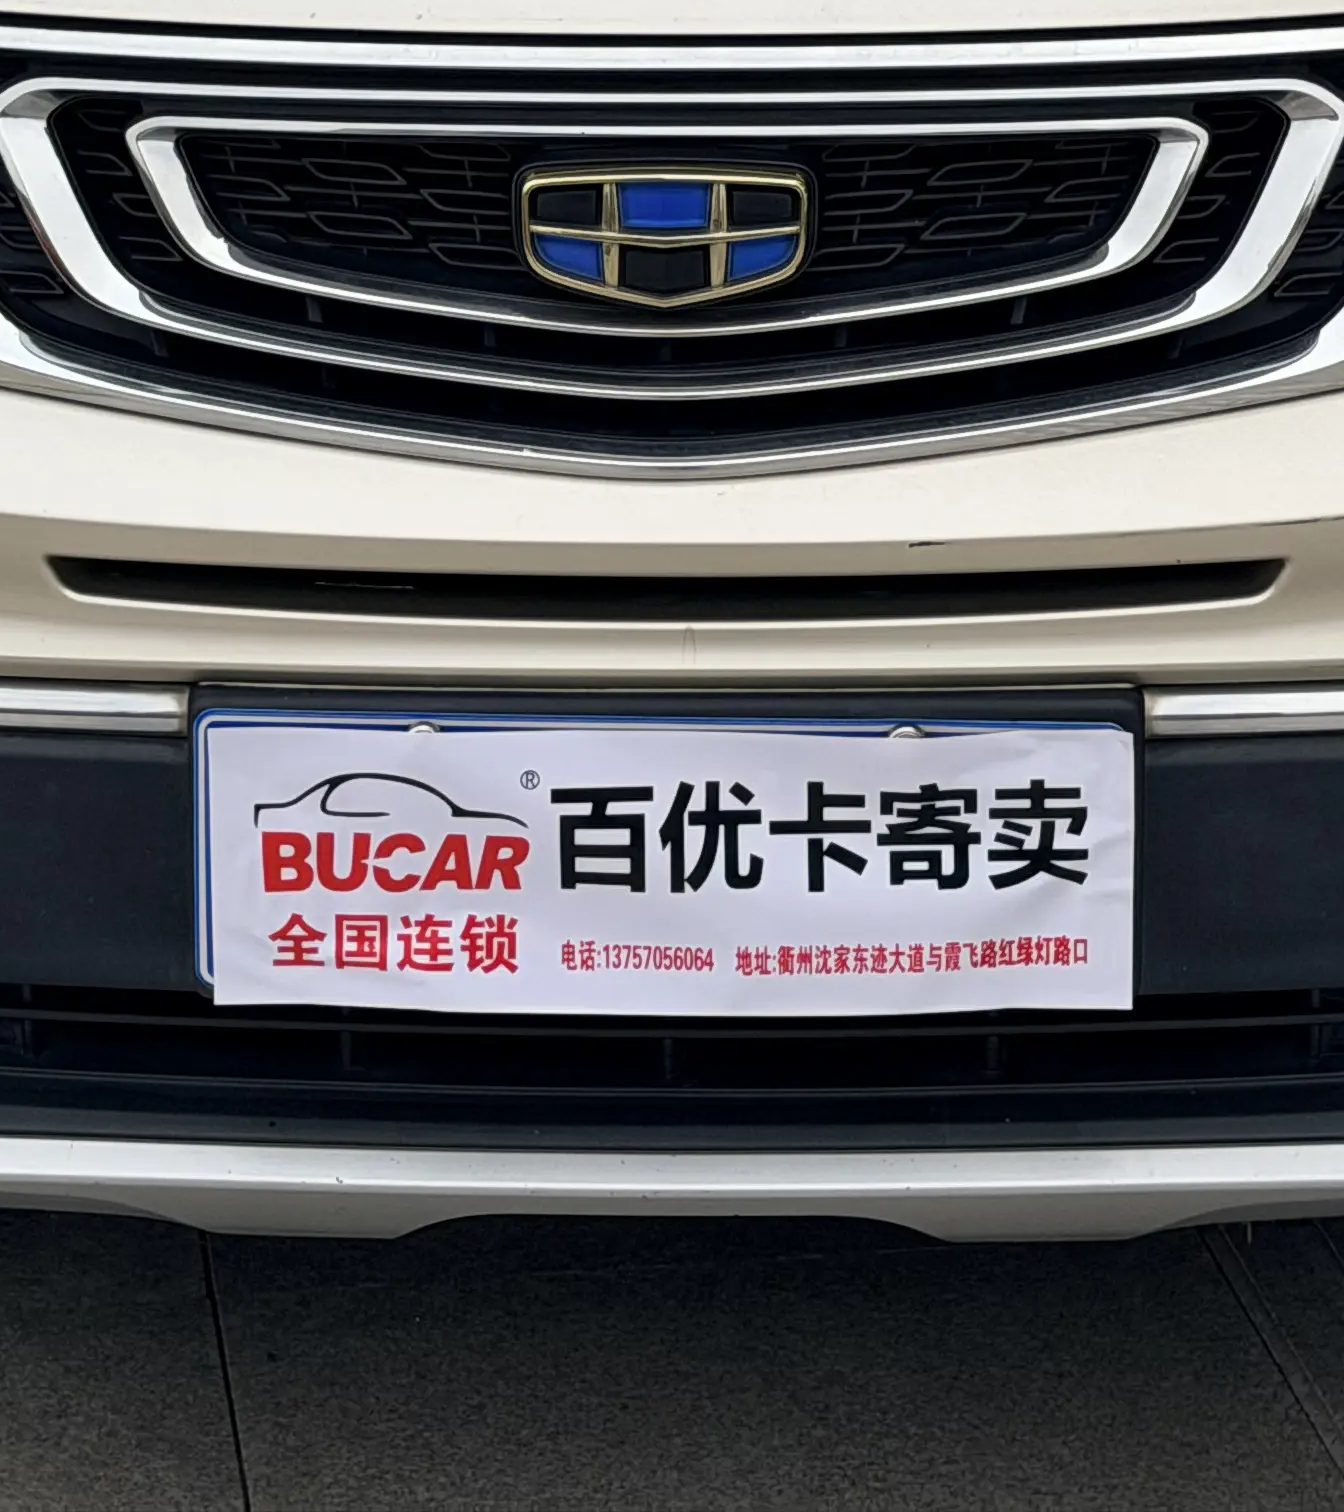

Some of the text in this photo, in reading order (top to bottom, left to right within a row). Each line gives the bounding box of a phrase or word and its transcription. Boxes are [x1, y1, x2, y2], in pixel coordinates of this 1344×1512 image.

[262, 831, 530, 893] BUCAR
[550, 778, 1089, 892] 百优卡寄卖
[268, 913, 520, 974] 全国连锁
